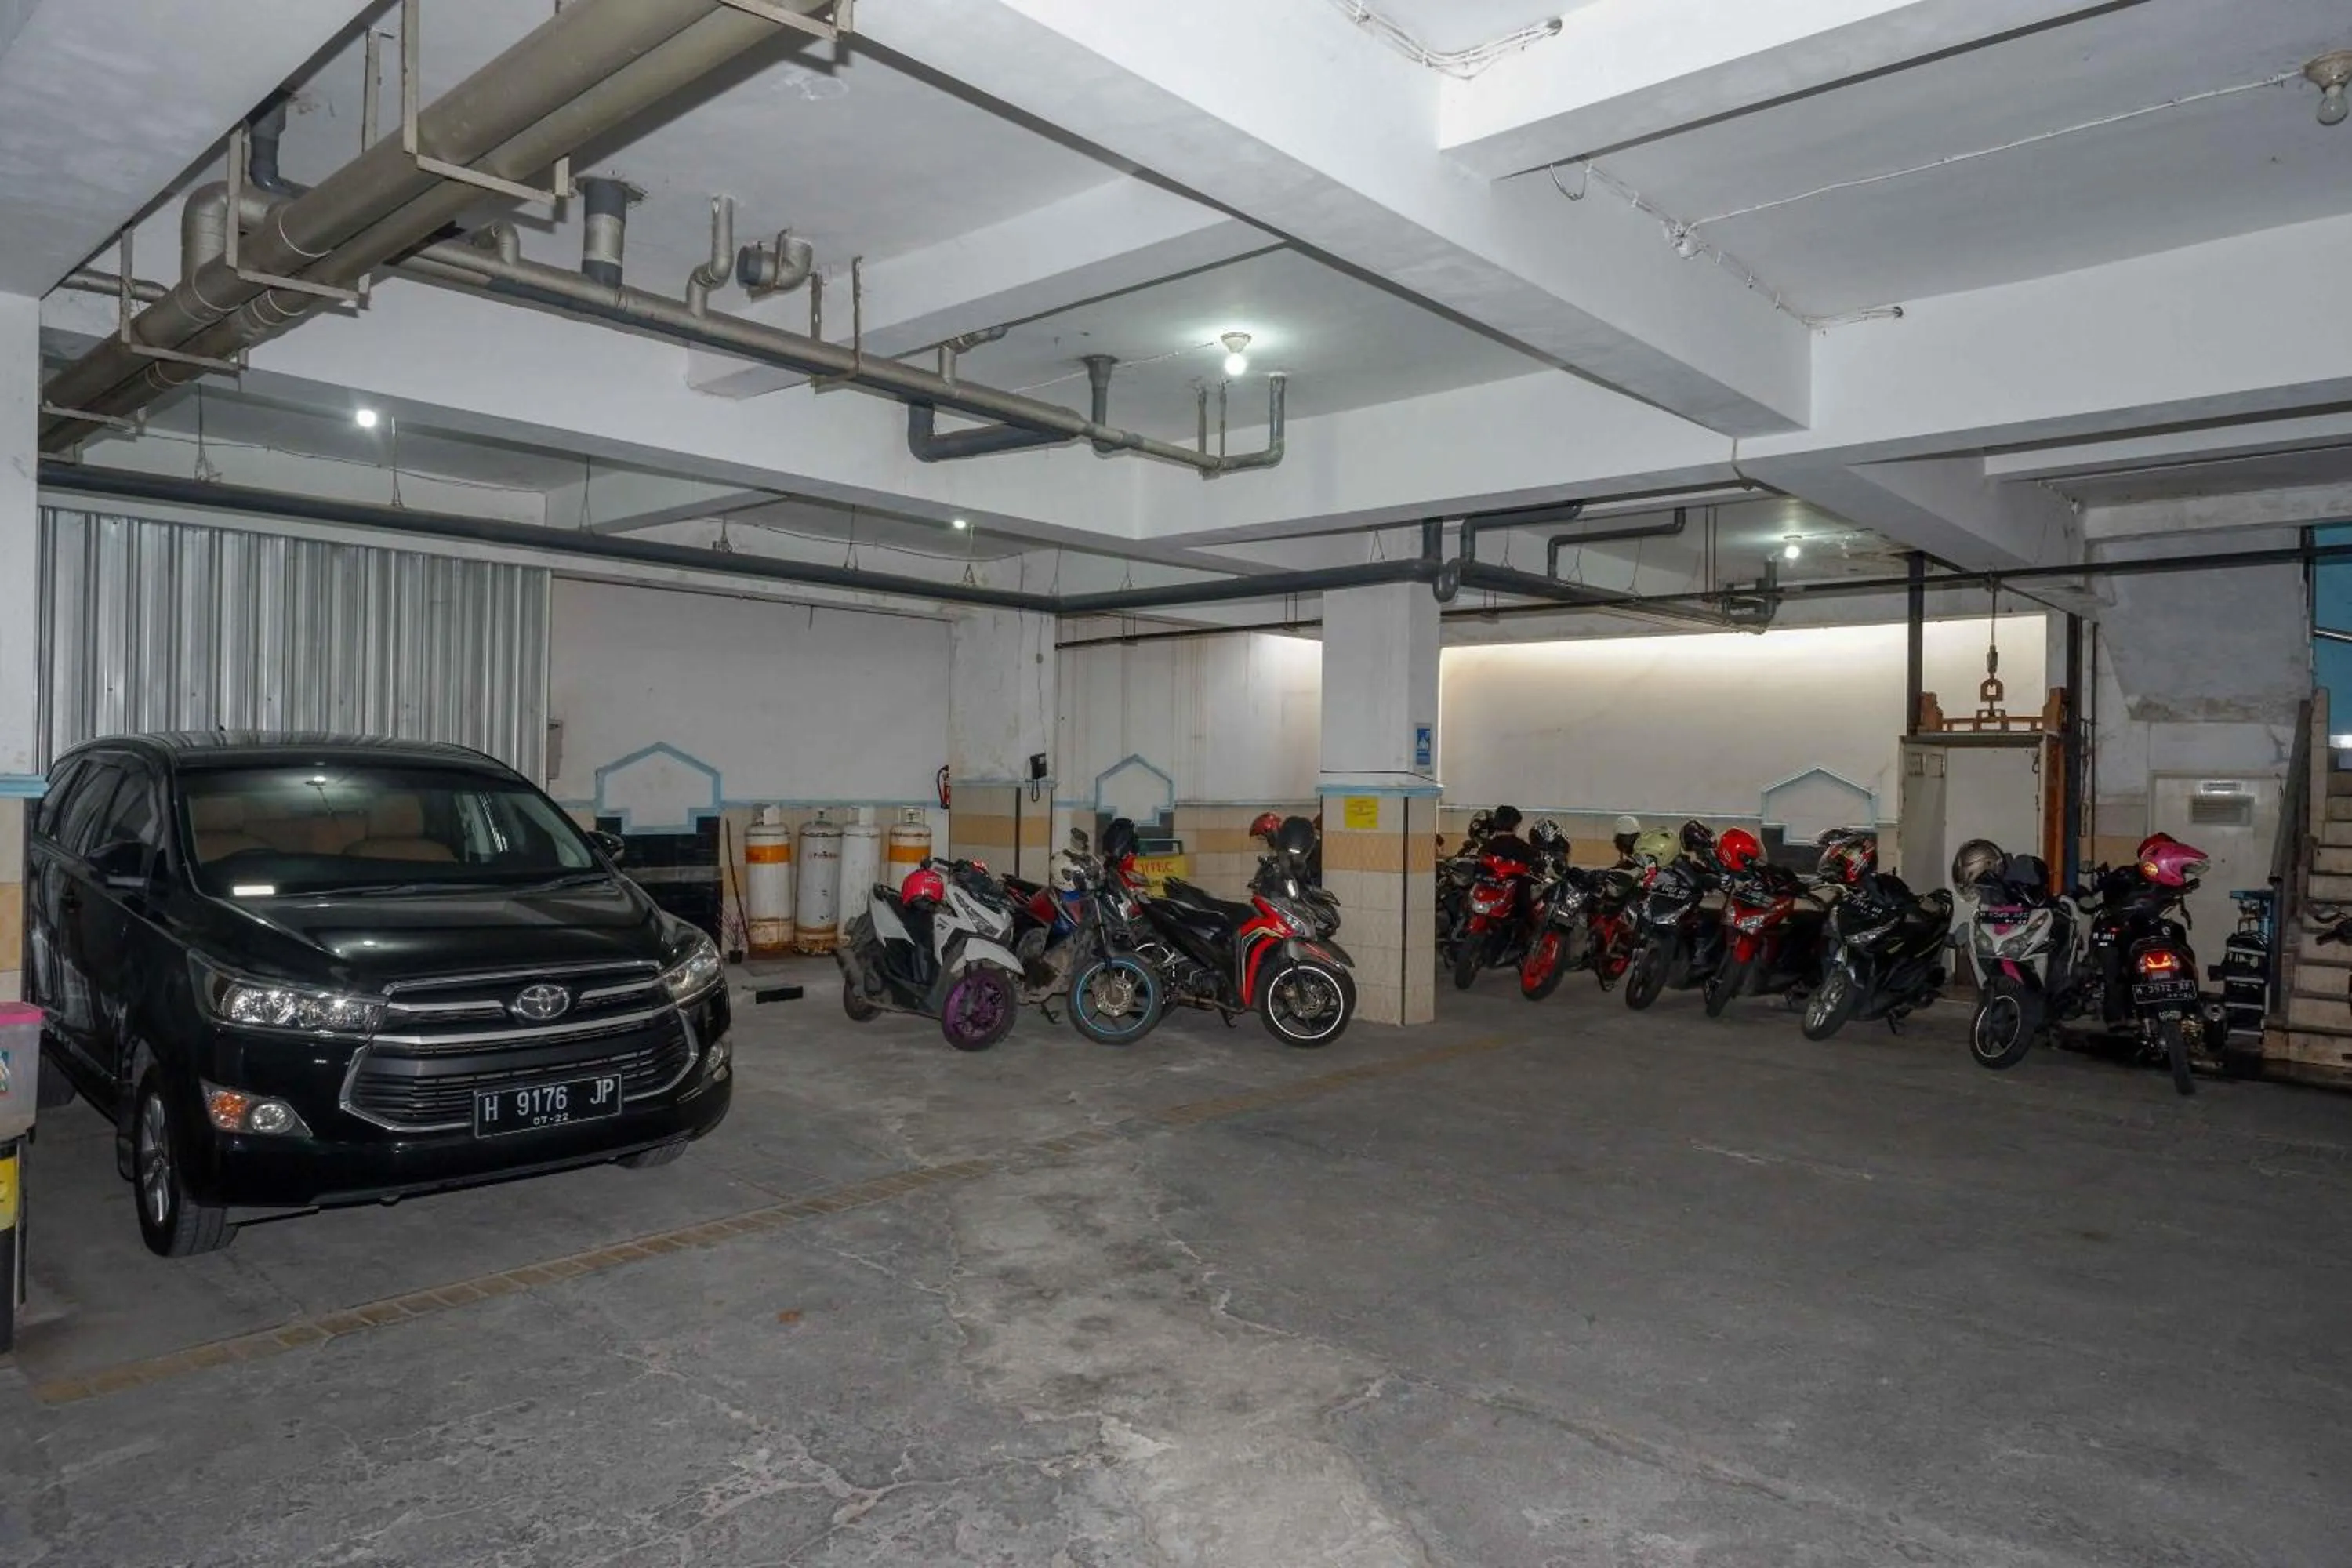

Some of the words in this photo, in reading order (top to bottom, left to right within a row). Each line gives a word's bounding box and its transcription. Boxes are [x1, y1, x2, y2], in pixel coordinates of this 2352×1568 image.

[485, 1095, 499, 1122] H
[517, 1086, 568, 1116] 9176
[590, 1078, 615, 1105] JP
